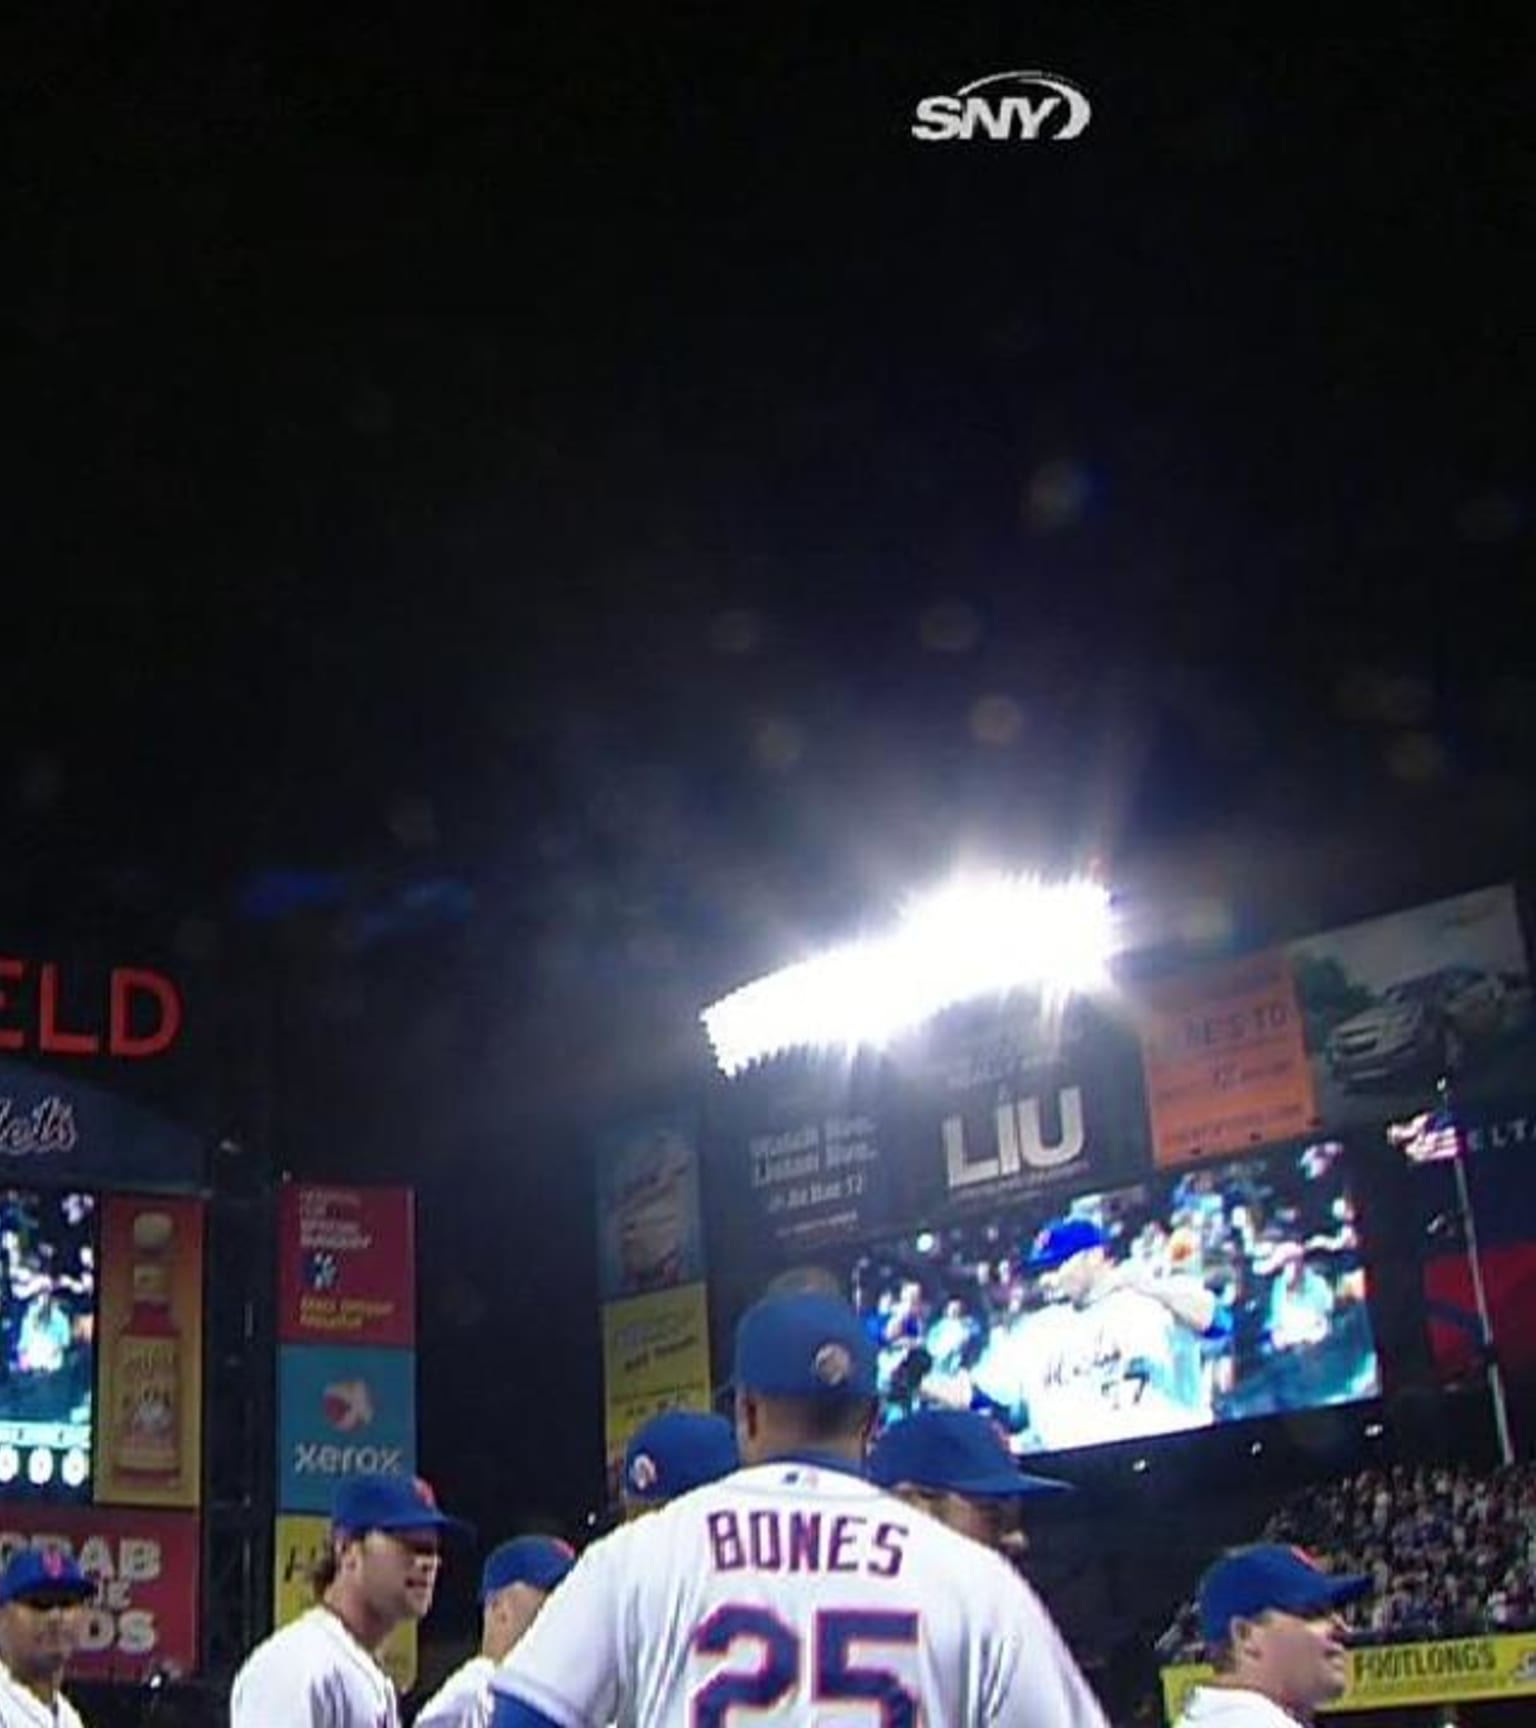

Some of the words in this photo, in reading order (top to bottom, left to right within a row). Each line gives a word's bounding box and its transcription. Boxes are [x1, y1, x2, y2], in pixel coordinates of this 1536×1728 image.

[941, 1084, 1085, 1188] LIU
[294, 1440, 401, 1476] xerox
[707, 1509, 910, 1578] BONES
[691, 1600, 921, 1728] 25
[1353, 1643, 1497, 1679] FOOTLONGS
